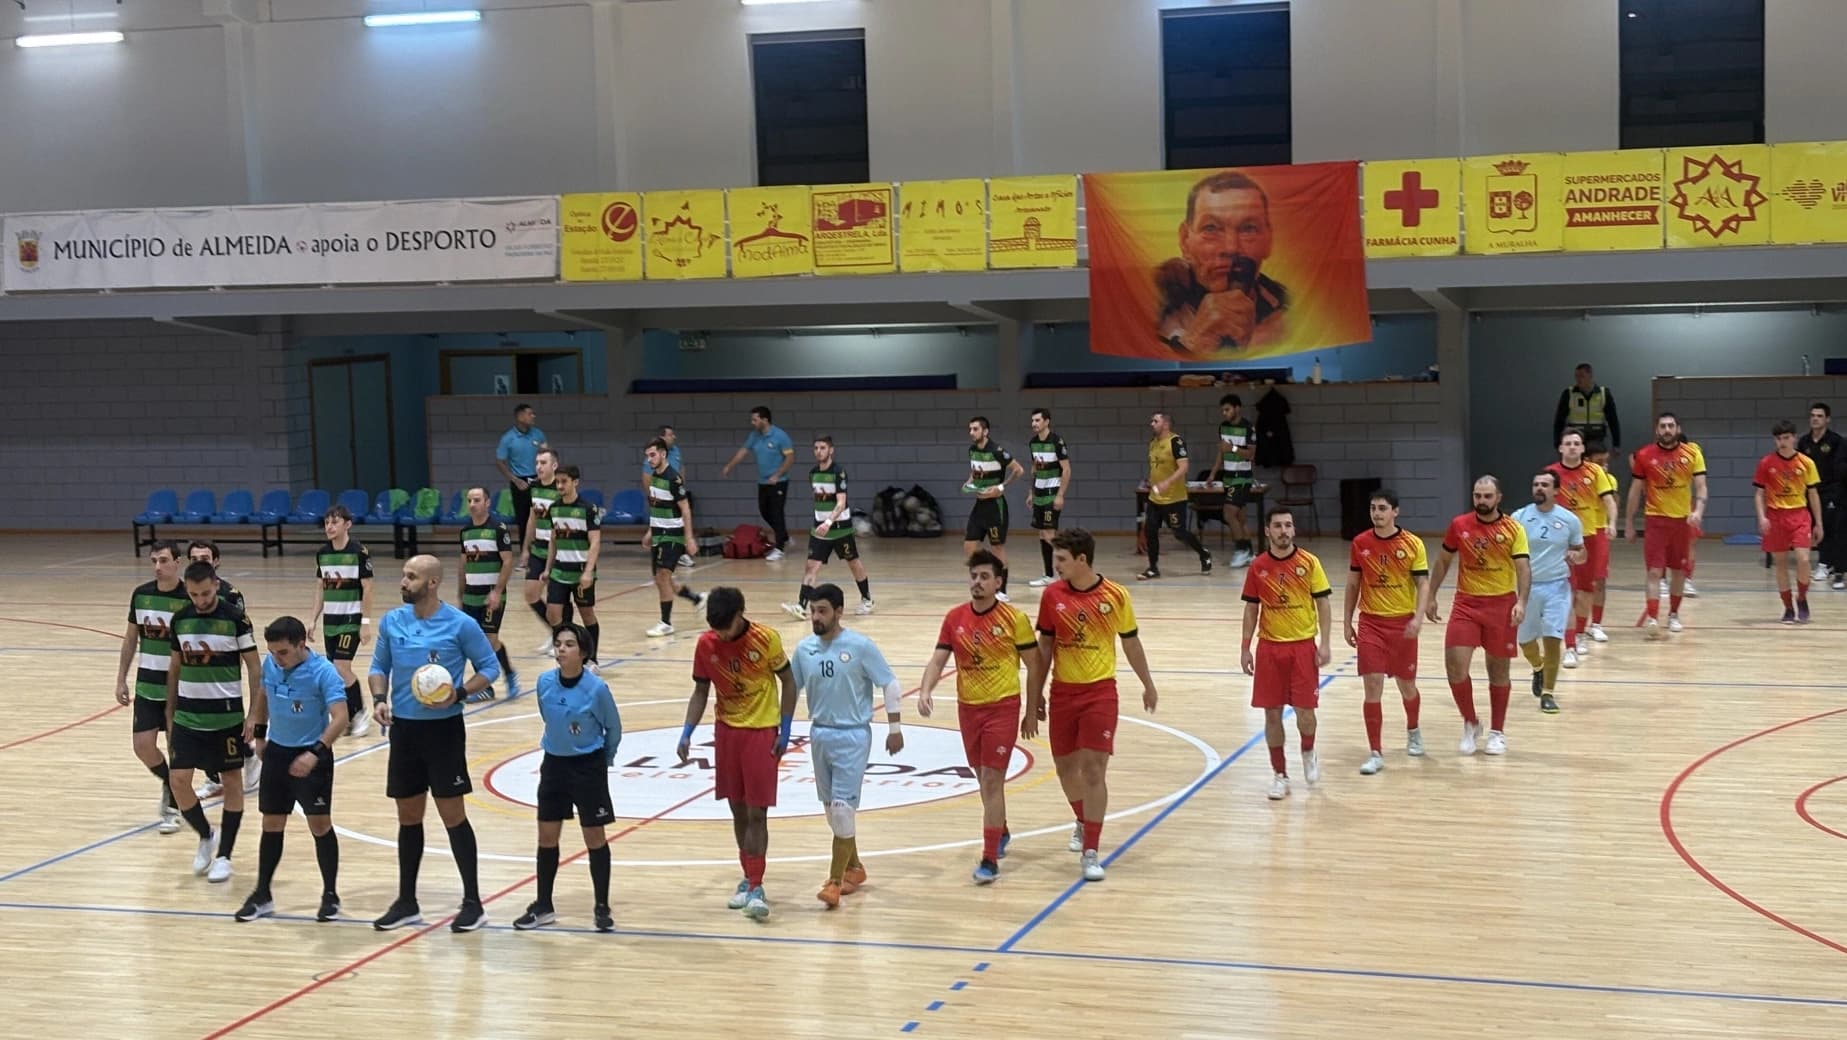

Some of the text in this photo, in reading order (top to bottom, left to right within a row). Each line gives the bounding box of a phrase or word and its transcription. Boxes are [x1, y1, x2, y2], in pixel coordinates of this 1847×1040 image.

[1565, 173, 1661, 185] SUPERMERCADOS
[1565, 186, 1661, 203] ANDRADE
[1572, 210, 1652, 222] AMANHECER
[53, 233, 165, 260] MUNICÍPIO
[172, 239, 193, 257] de
[200, 235, 291, 256] ALMEIDA
[311, 233, 359, 257] apoia
[366, 238, 379, 252] o
[386, 229, 496, 251] DESPORTO
[1366, 235, 1457, 247] FARMÁCIA CUNHA
[1540, 526, 1549, 540] 2
[340, 635, 352, 649] 10
[728, 658, 742, 673] 10
[819, 660, 834, 678] 18
[226, 738, 237, 756] 6
